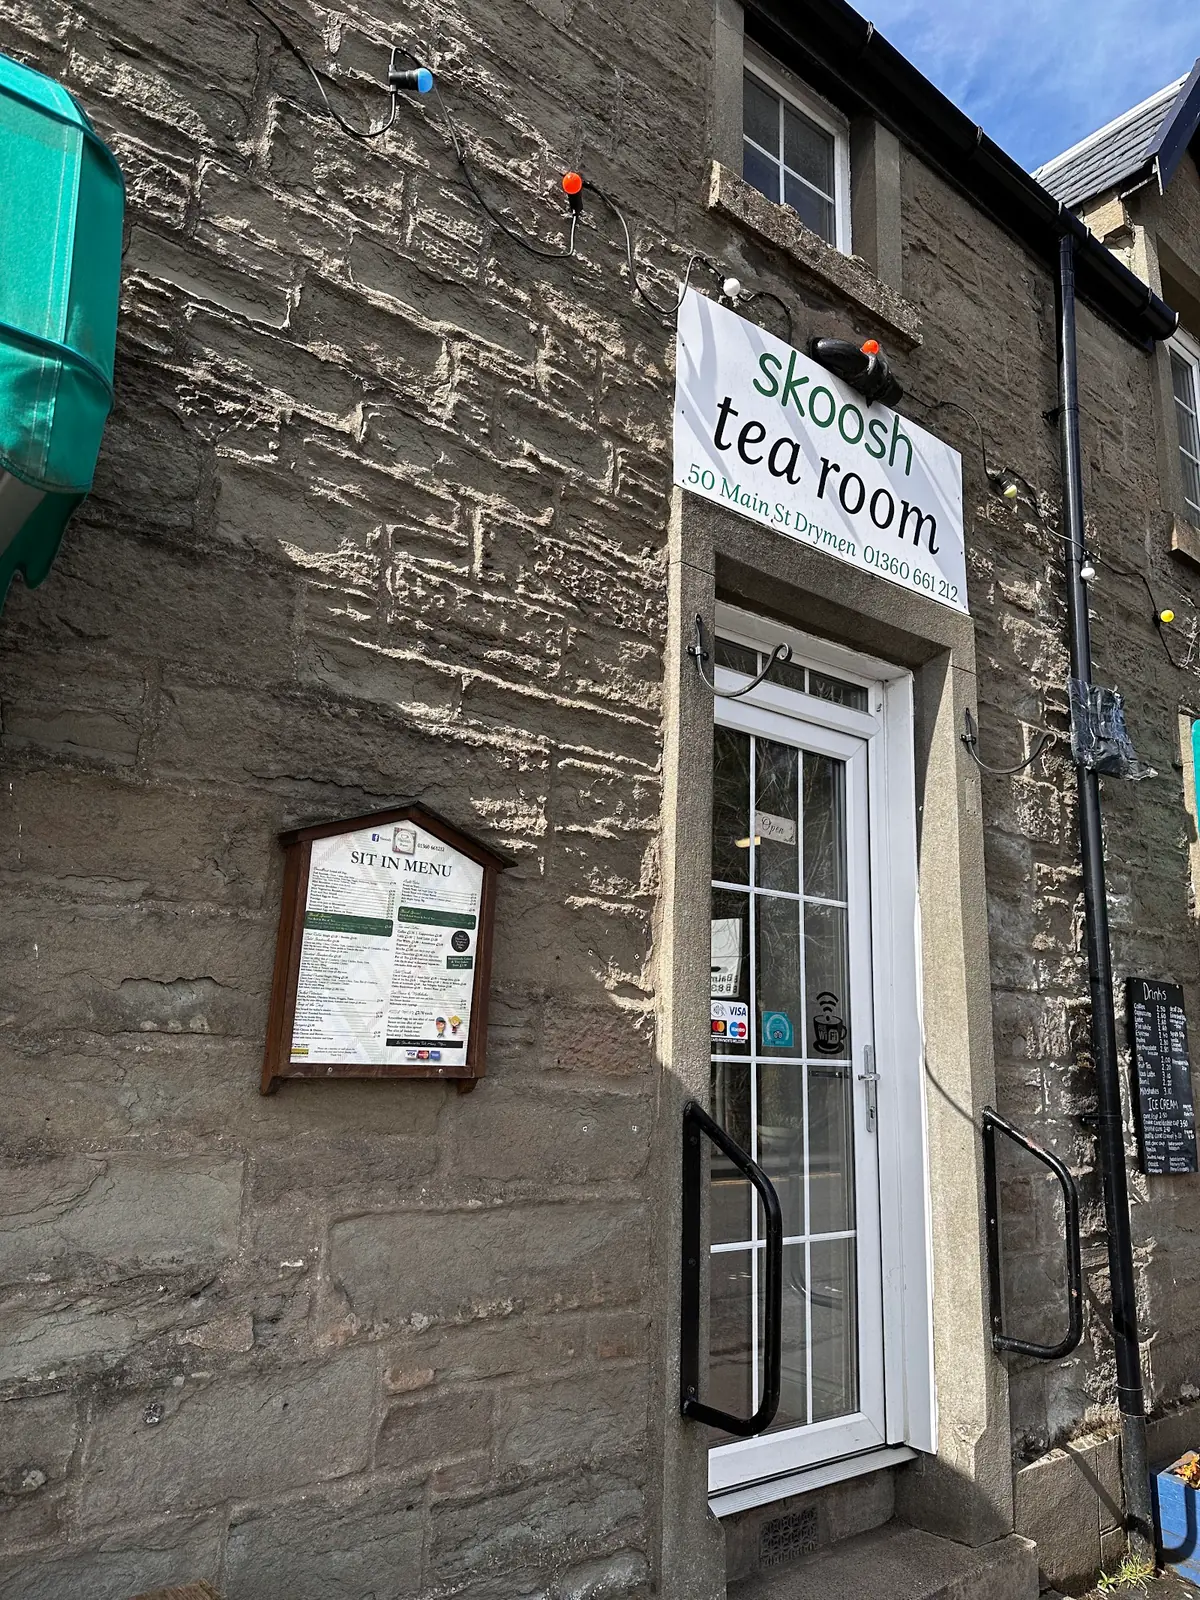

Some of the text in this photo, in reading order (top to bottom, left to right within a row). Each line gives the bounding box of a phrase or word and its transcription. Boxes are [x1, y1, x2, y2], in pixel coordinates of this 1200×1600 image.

[753, 350, 913, 476] skoosh
[713, 396, 940, 555] tea room
[687, 463, 959, 603] 50 Main St Drymen 01360 661 212
[762, 816, 785, 836] Open
[351, 851, 452, 878] SIT IN MENU
[1143, 982, 1167, 1001] Drinks
[729, 1006, 747, 1017] VISA
[1147, 1097, 1159, 1111] ICE
[1160, 1098, 1179, 1111] CREAM
